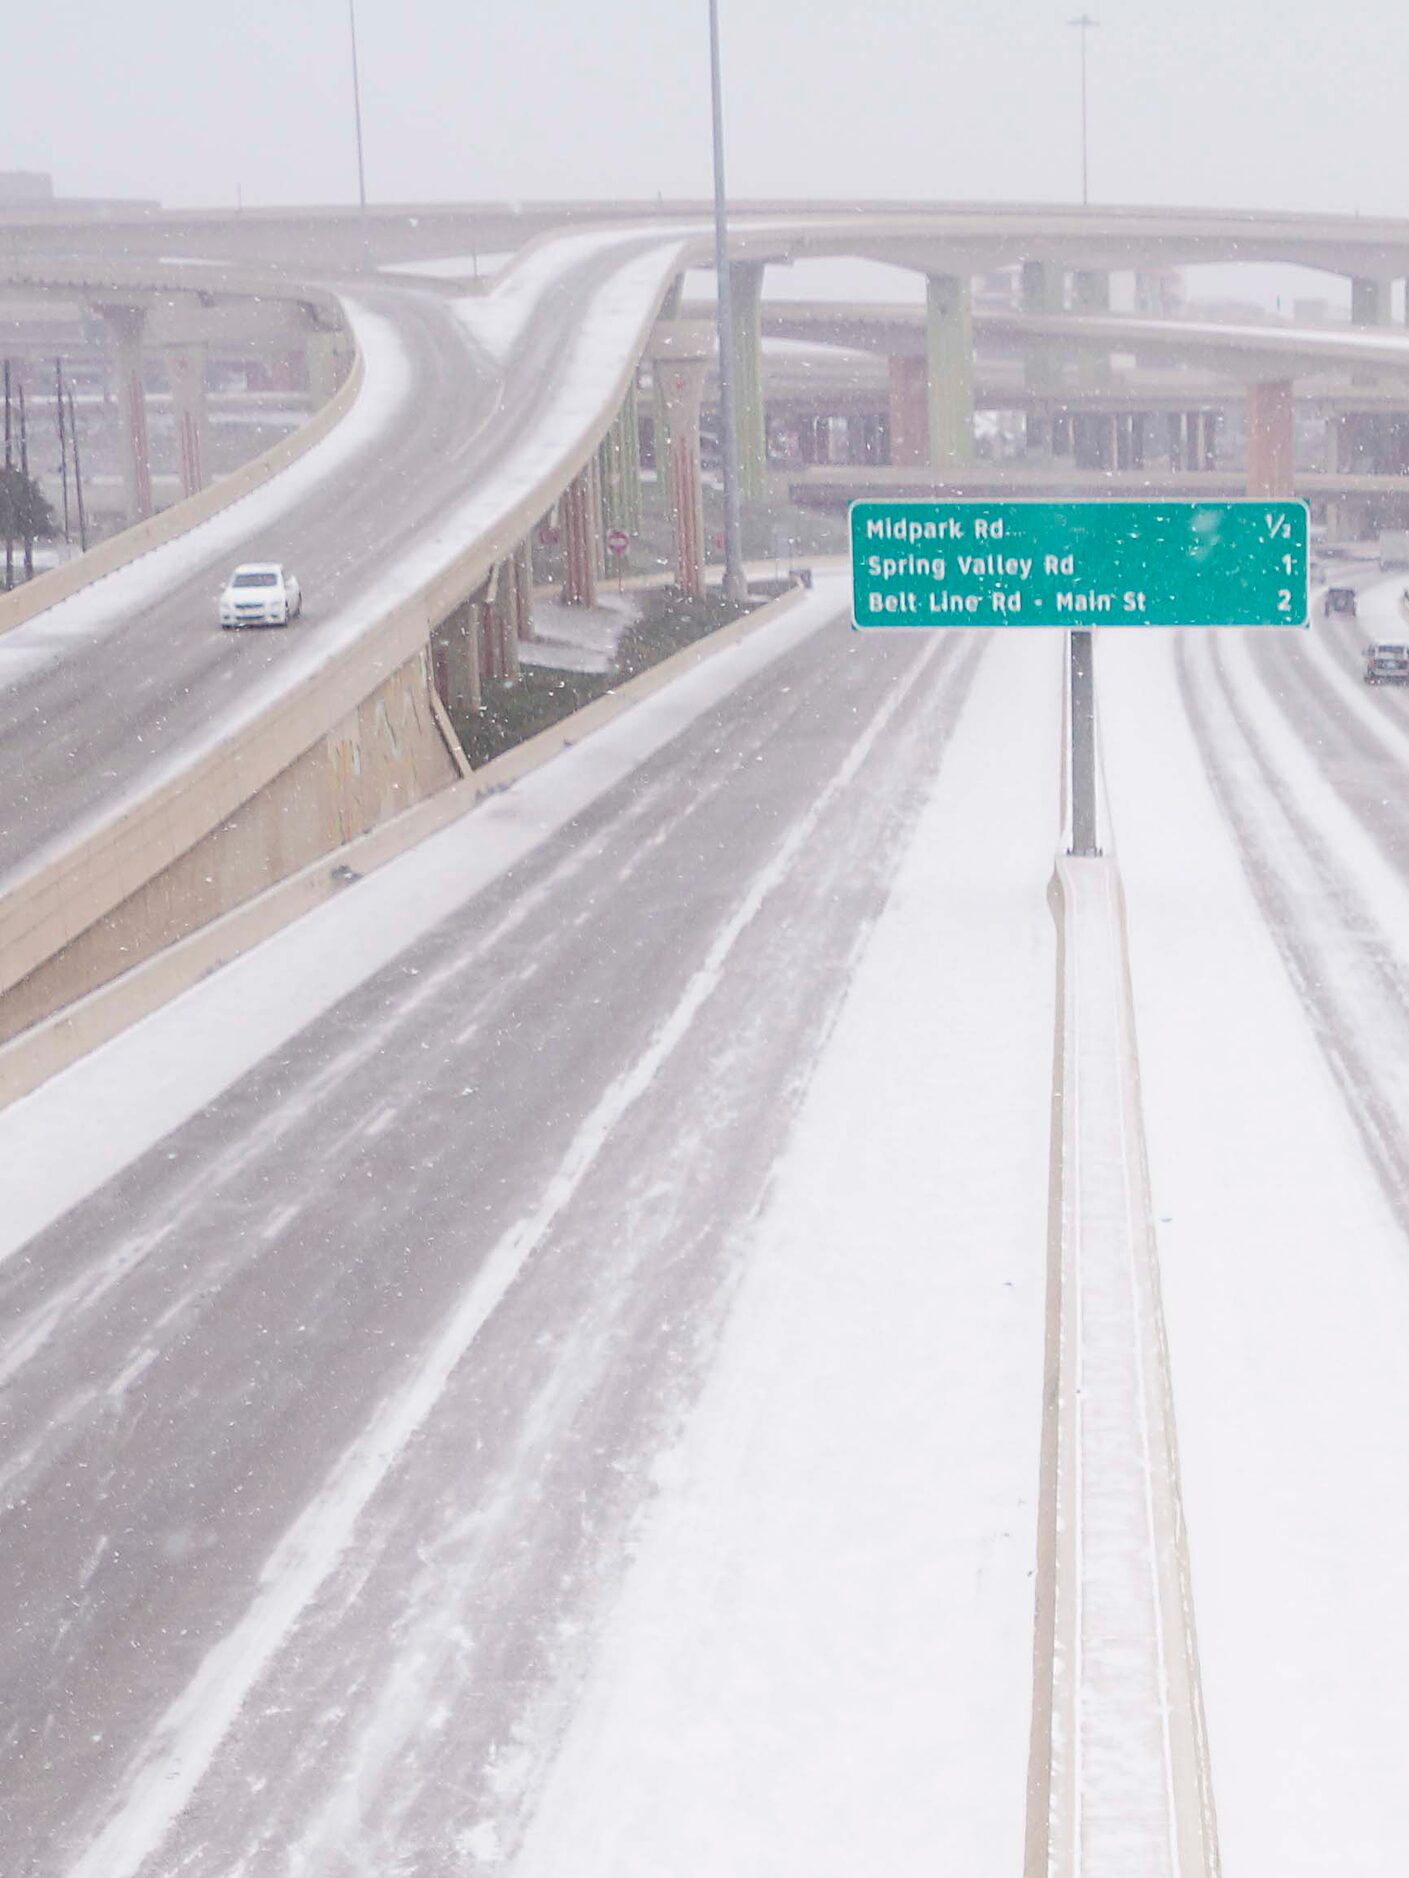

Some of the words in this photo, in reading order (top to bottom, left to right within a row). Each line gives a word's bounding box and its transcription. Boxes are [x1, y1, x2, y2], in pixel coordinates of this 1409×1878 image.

[866, 517, 964, 544] Midpark
[974, 518, 1004, 539] Rd
[868, 553, 945, 581] Spring
[957, 553, 1033, 581] Valley
[1045, 554, 1074, 576] Rd
[1282, 554, 1293, 575] 1
[868, 591, 917, 612] Belt
[929, 590, 979, 612] Line
[992, 591, 1022, 612] Rd
[1055, 589, 1111, 612] Main
[1122, 590, 1147, 612] St
[1277, 588, 1292, 612] 2
